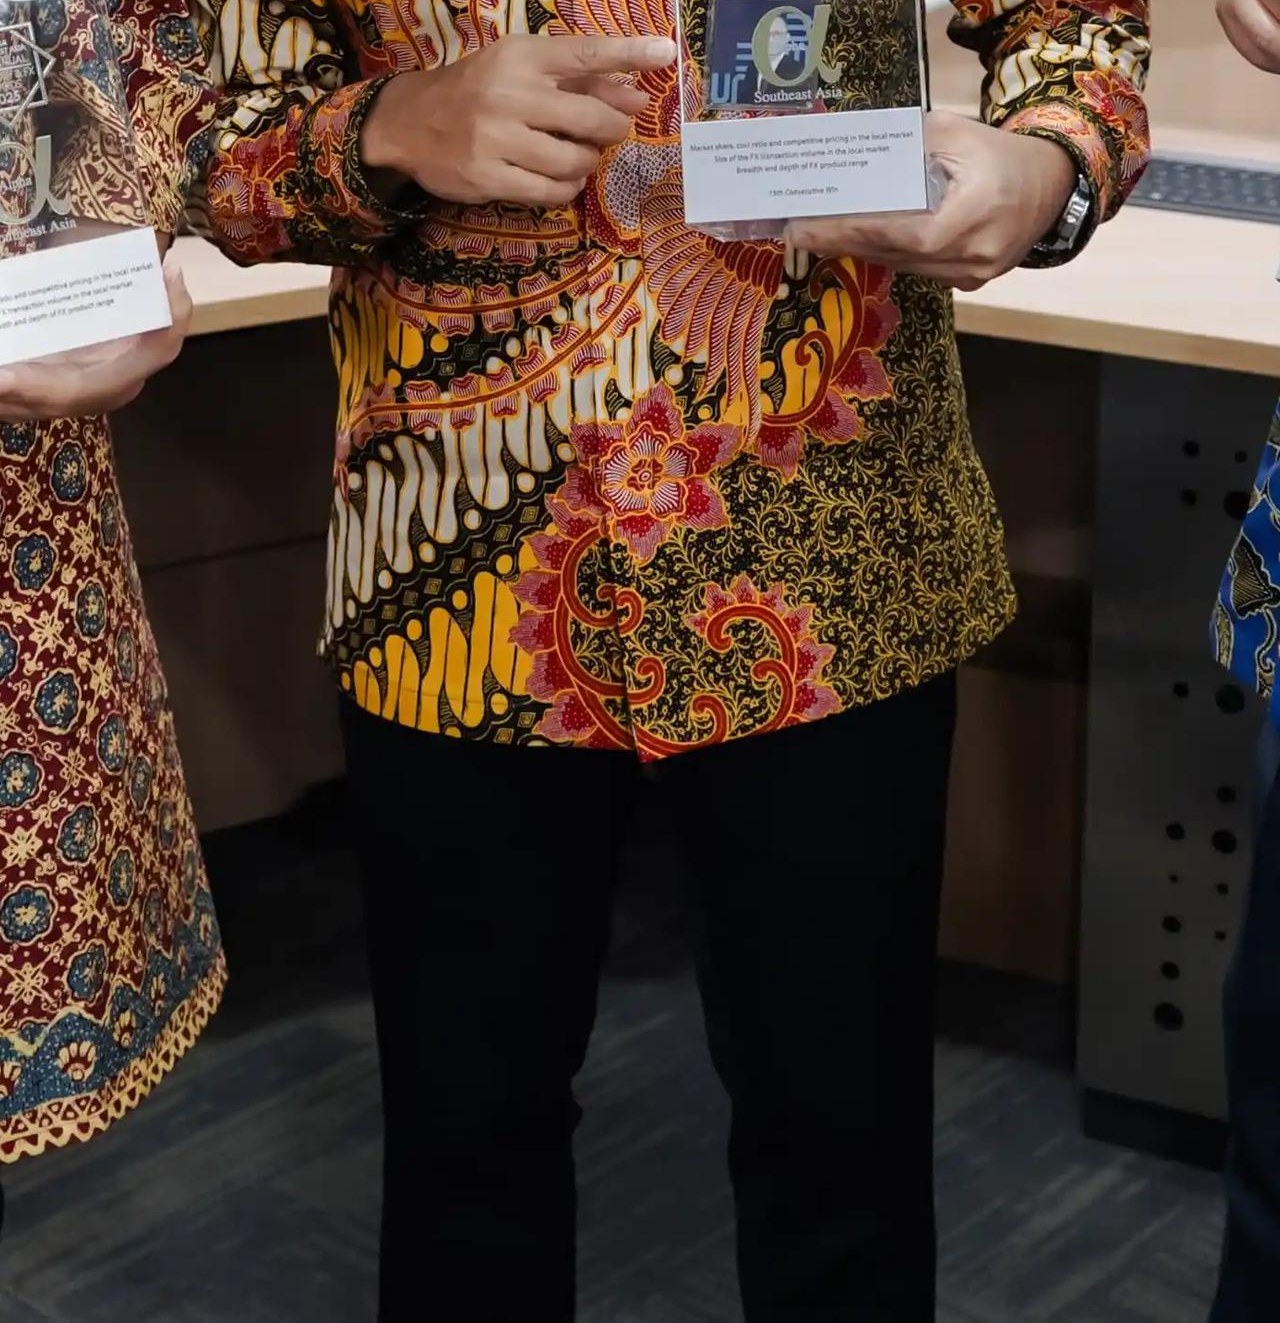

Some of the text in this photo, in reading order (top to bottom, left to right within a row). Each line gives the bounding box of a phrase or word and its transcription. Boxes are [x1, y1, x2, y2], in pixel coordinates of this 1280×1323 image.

[754, 86, 842, 103] Southeast Asia
[769, 139, 781, 147] and
[783, 137, 823, 146] competitive
[825, 135, 849, 144] pricing
[871, 132, 887, 140] local
[888, 130, 913, 139] market
[760, 151, 798, 159] transaction
[848, 147, 864, 155] local
[865, 145, 890, 153] market
[736, 165, 763, 174] Breadth
[779, 163, 800, 172] depth
[819, 160, 847, 170] product
[848, 160, 868, 168] range
[0, 176, 32, 195] Alpha
[50, 217, 77, 232] Asia
[14, 291, 27, 299] and
[69, 277, 92, 287] pricing
[113, 268, 129, 277] local
[130, 262, 153, 273] market
[80, 290, 92, 298] the
[93, 285, 108, 295] local
[109, 280, 133, 290] market
[14, 317, 27, 326] and
[28, 312, 48, 324] depth
[68, 302, 95, 315] product
[96, 298, 114, 307] range
